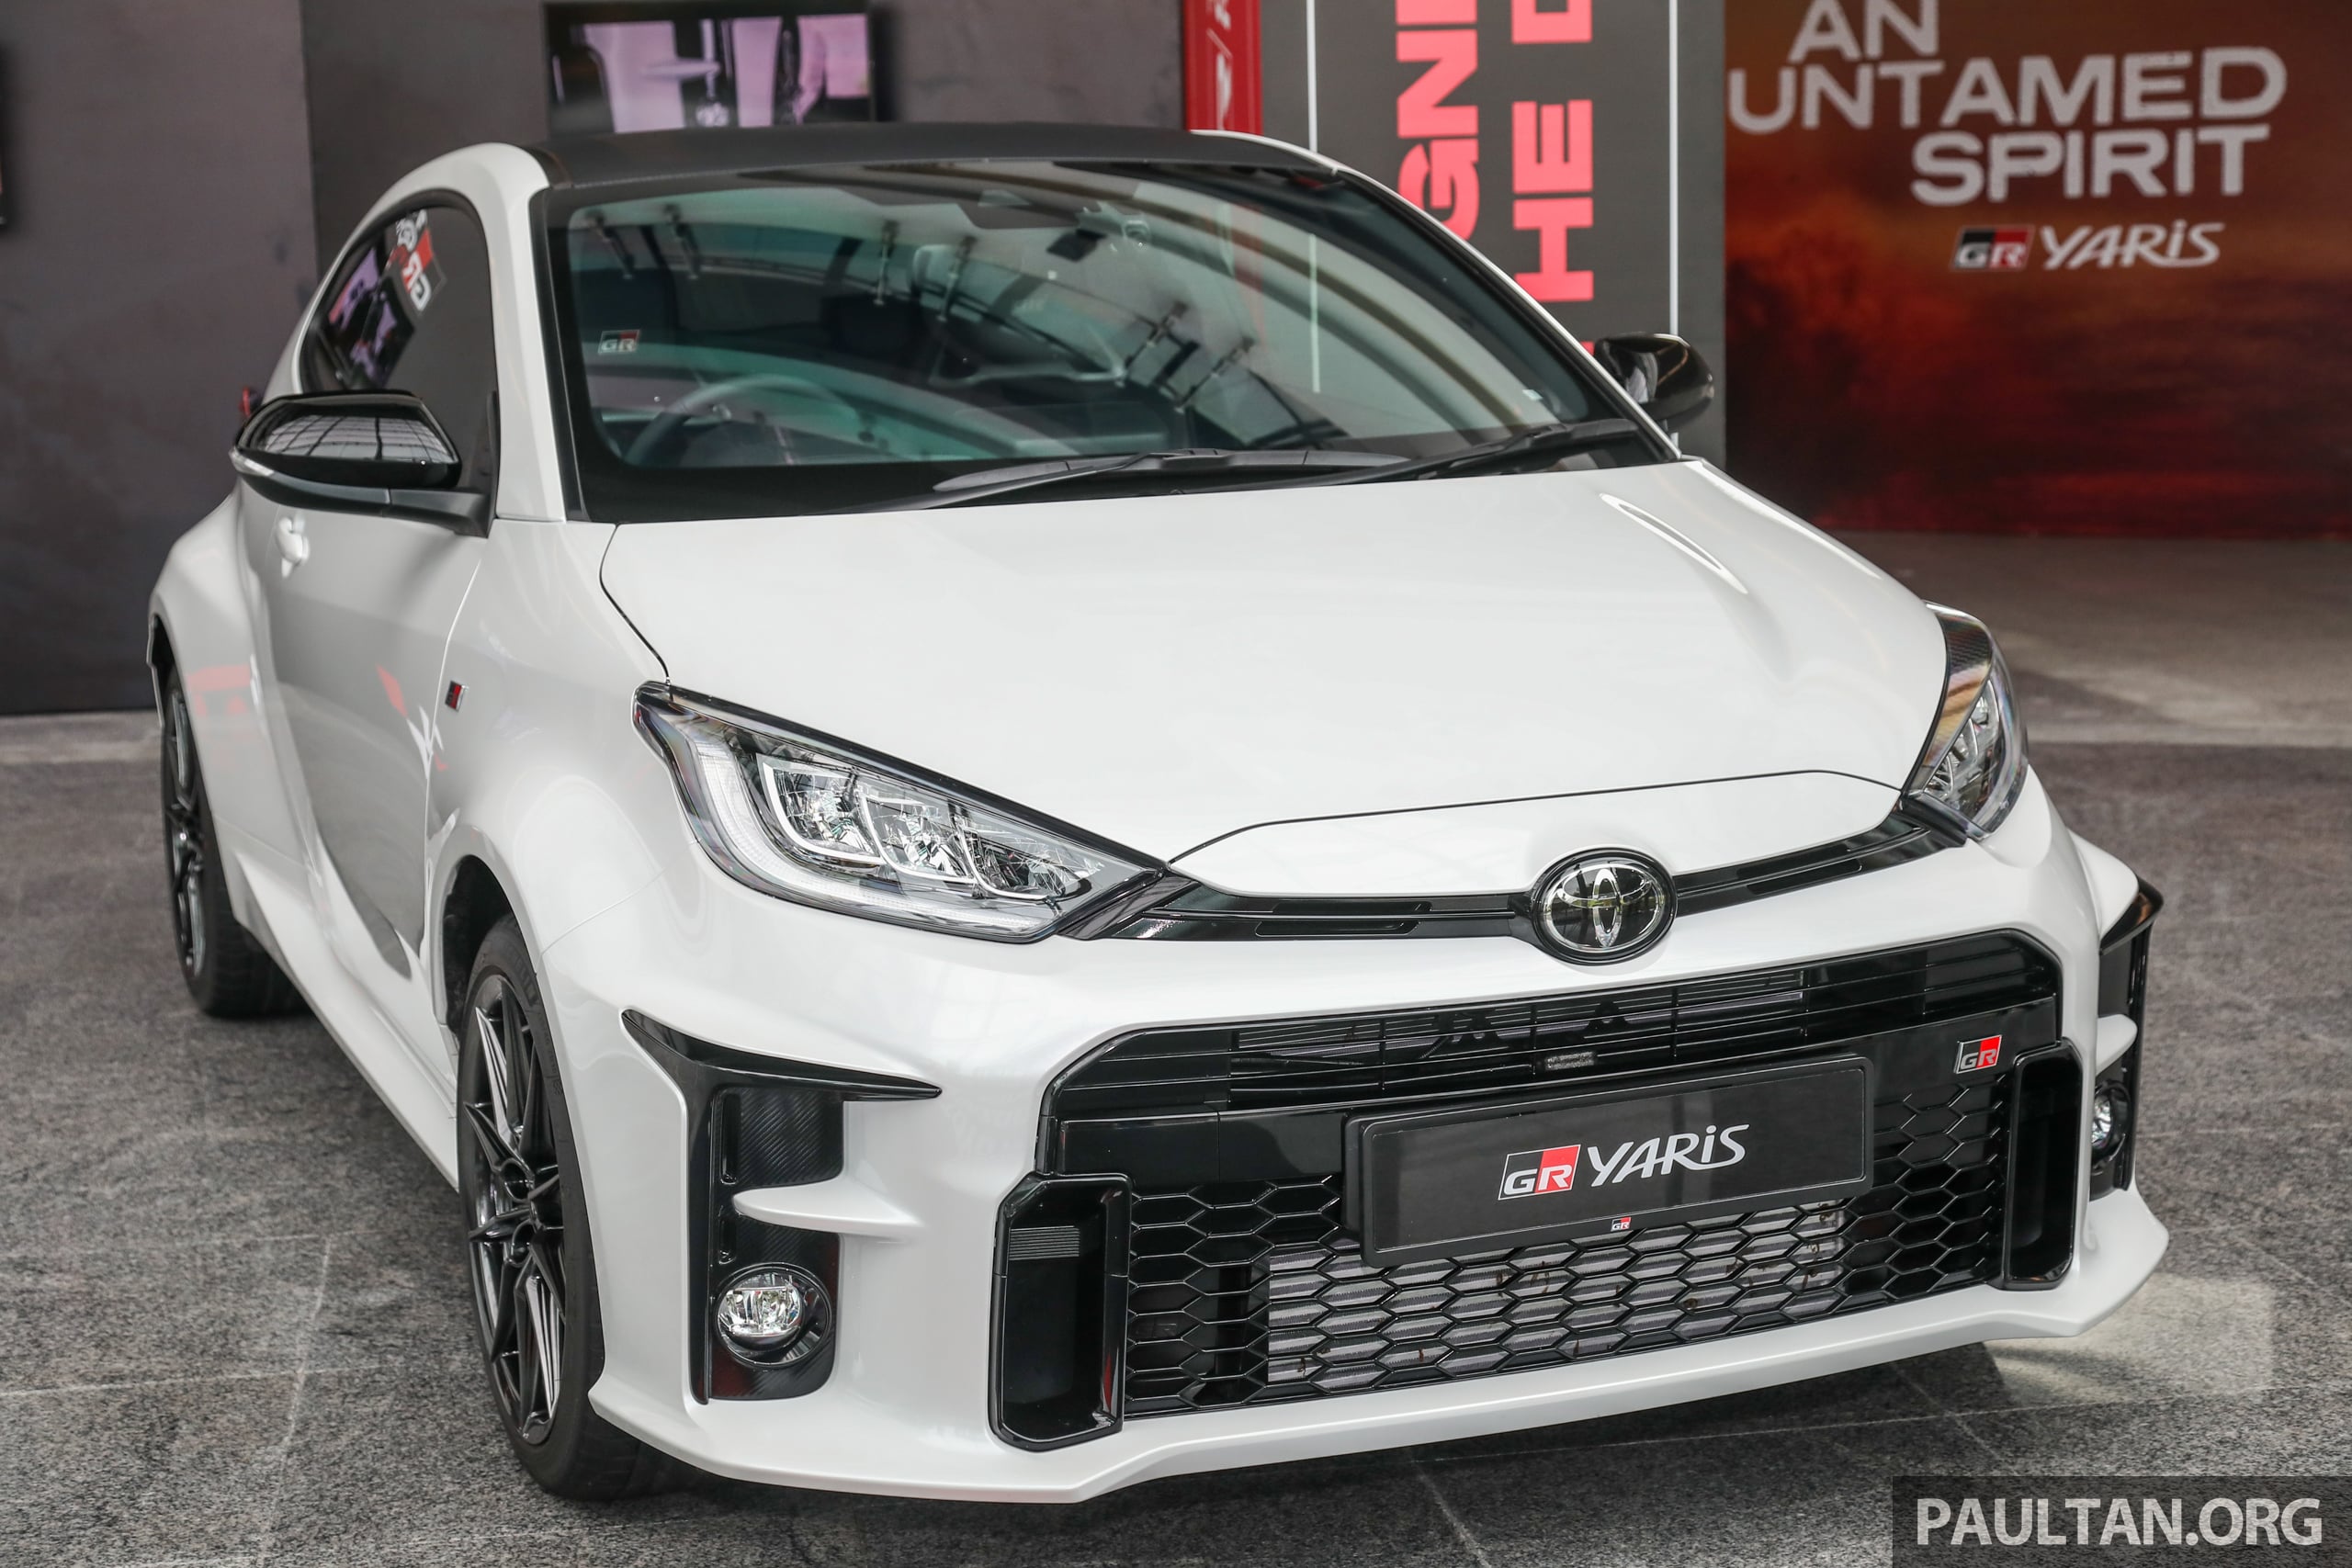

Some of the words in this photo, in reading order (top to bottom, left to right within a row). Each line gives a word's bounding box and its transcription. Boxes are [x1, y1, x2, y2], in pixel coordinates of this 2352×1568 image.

[1788, 0, 1939, 63] AN
[1728, 46, 2288, 135] UNTAMED
[1911, 124, 2271, 207] SPIRIT
[1511, 99, 1594, 355] HE
[1953, 242, 2029, 269] GR
[600, 338, 637, 354] GR
[1959, 1047, 1998, 1070] GR
[1502, 1162, 1574, 1195] GR
[1611, 1222, 1631, 1231] GR
